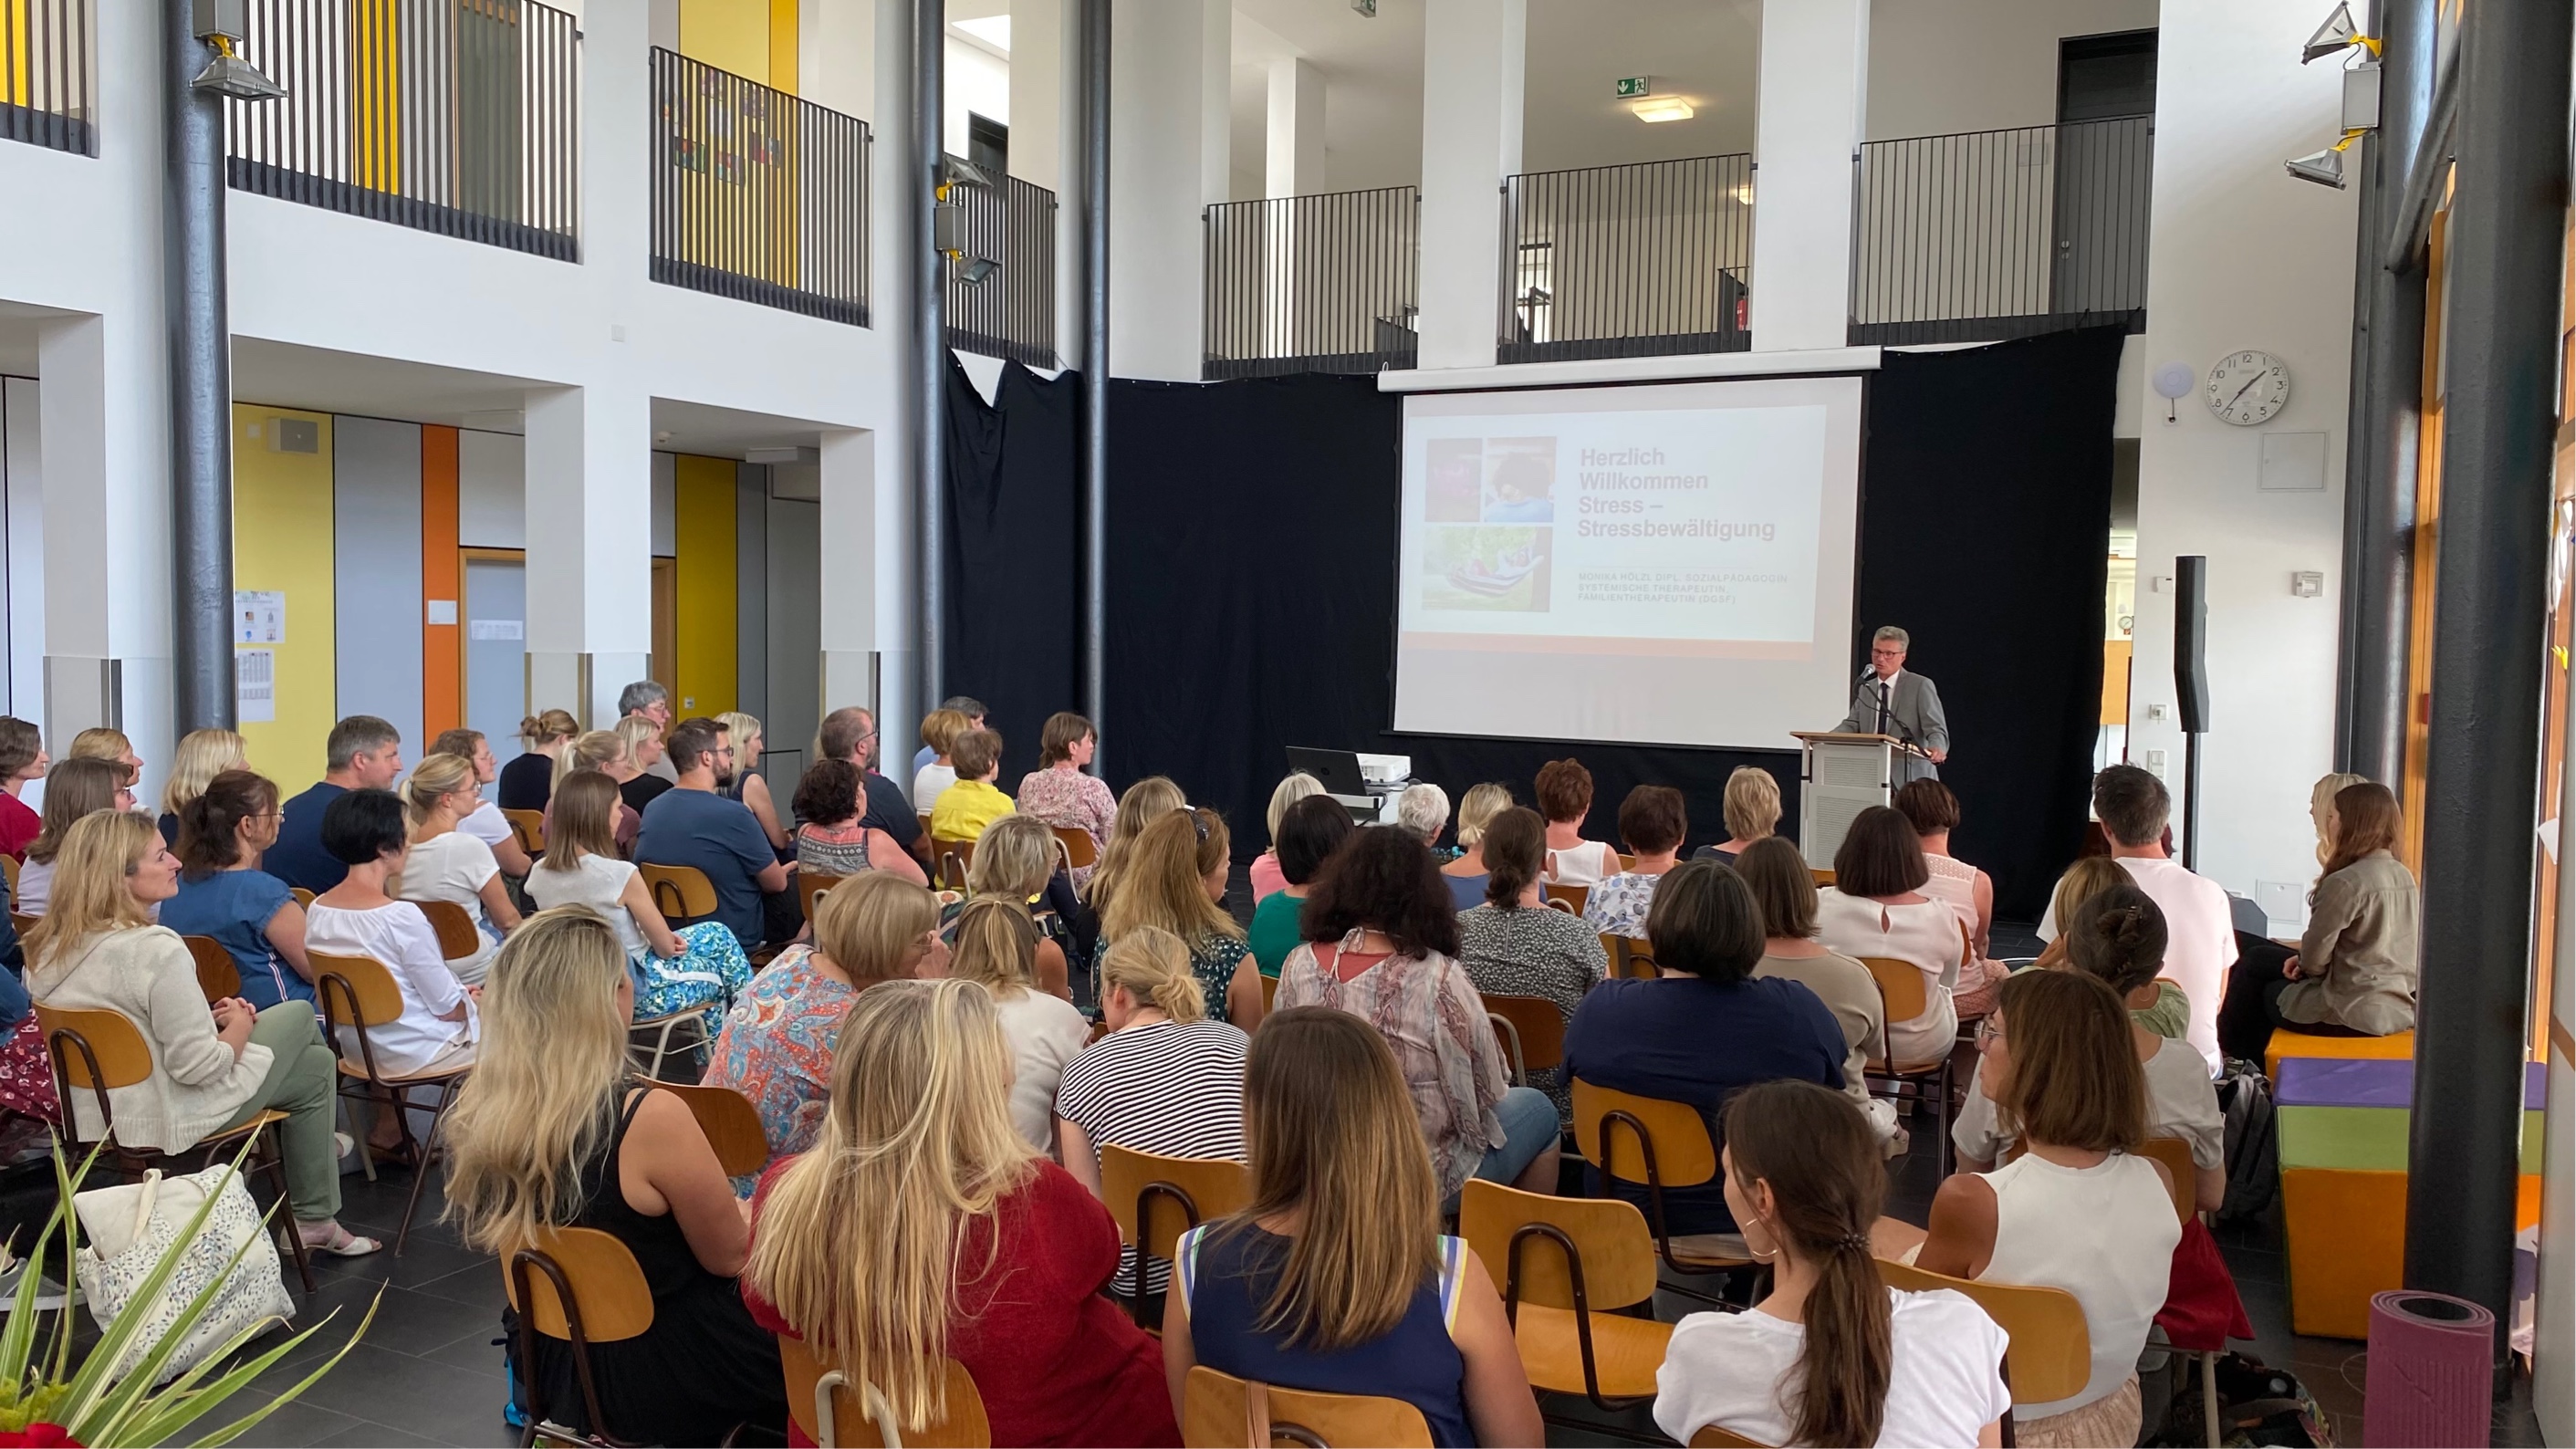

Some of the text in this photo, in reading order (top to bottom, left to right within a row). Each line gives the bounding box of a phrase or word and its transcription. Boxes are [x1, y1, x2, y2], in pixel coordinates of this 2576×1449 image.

[2242, 353, 2252, 363] 12
[2262, 357, 2267, 366] 1
[2227, 359, 2237, 369] 11
[2216, 370, 2226, 379] 10
[2271, 367, 2280, 376] 2
[2210, 384, 2218, 393] 9
[2276, 380, 2284, 391] 3
[2215, 398, 2222, 408] 8
[2269, 395, 2279, 404] 4
[2227, 407, 2235, 417] 7
[2259, 406, 2267, 416] 5
[2241, 412, 2250, 422] 6
[1580, 447, 1665, 466] Herzlich
[1580, 472, 1708, 490] Willkommen
[1578, 495, 1644, 514] Stress
[1578, 518, 1775, 542] Stressbewältigung
[1578, 572, 1617, 581] MONIKA
[1578, 583, 1650, 592] SYSTEMISCHE
[1578, 593, 1695, 602] FAMILIENTHERAPEUTIN
